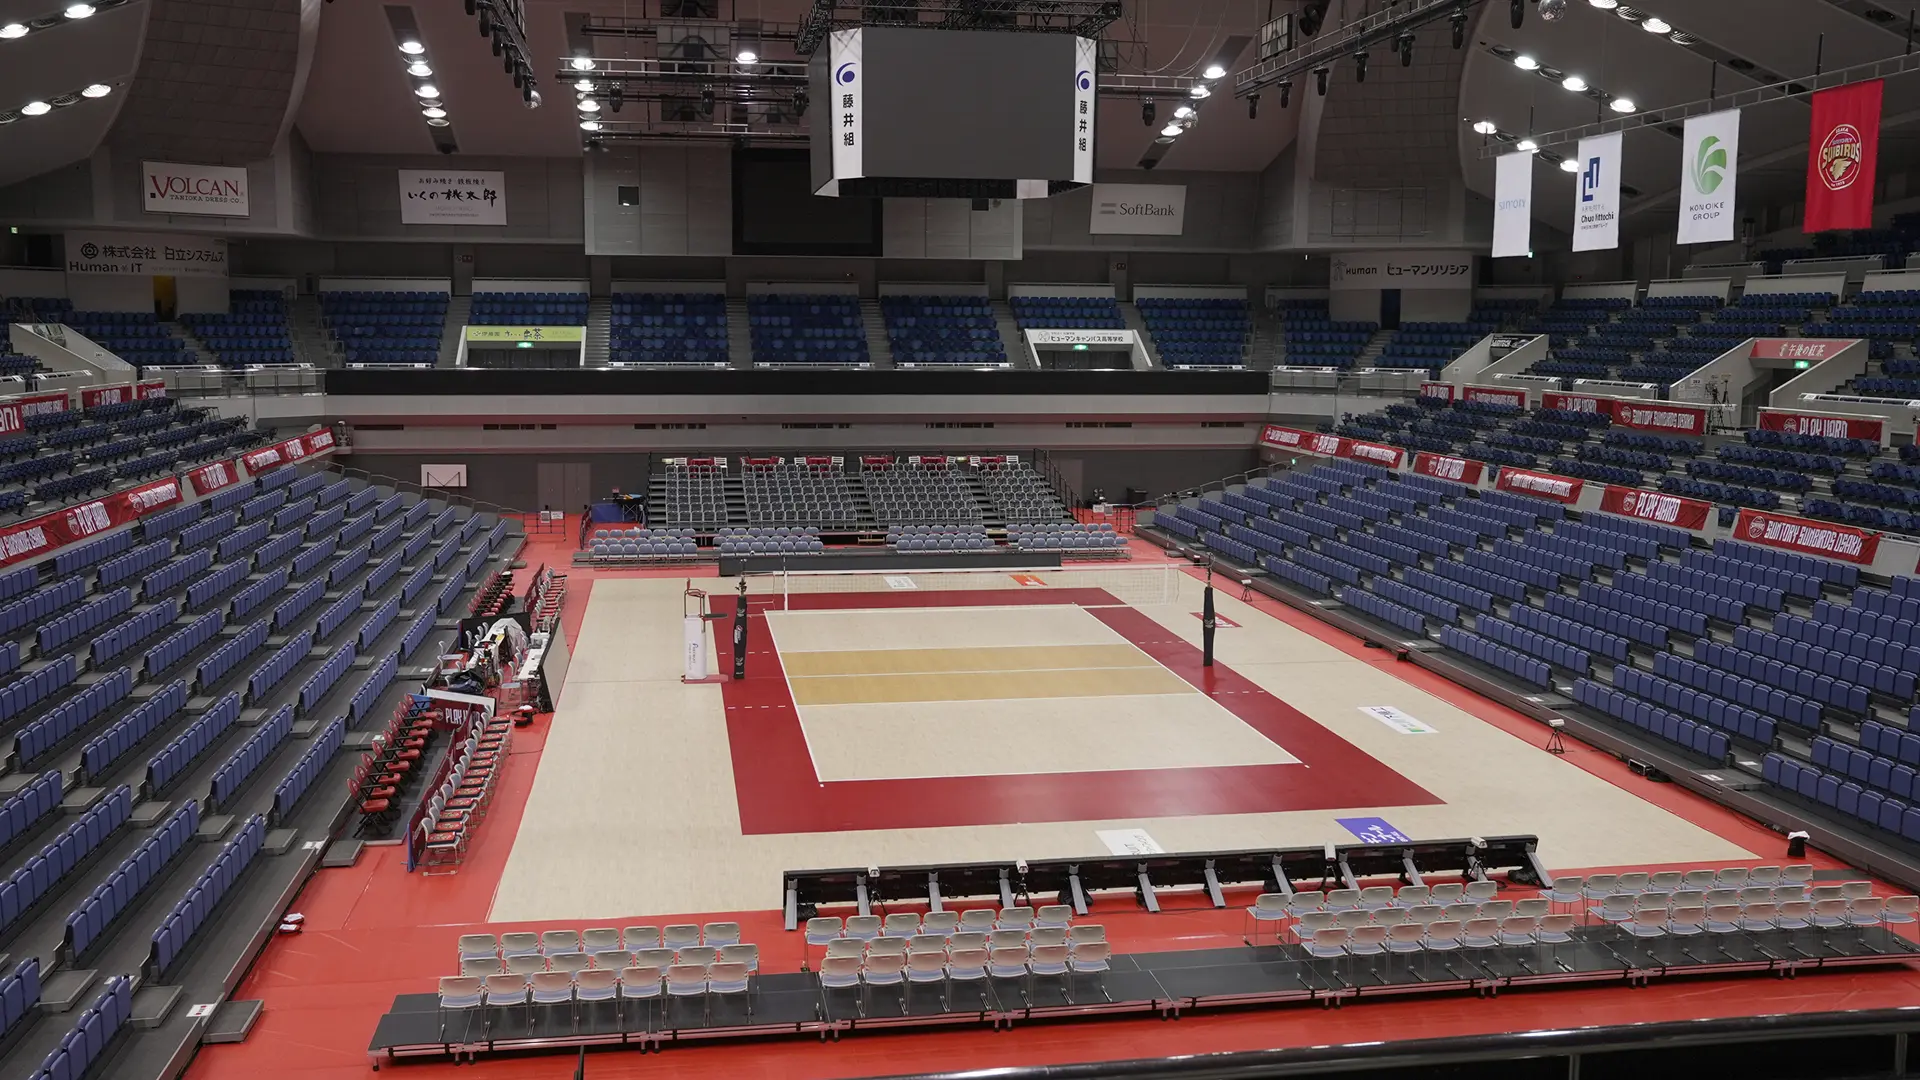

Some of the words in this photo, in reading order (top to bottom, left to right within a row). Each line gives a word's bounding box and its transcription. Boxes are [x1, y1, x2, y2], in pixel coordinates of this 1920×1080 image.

[842, 93, 855, 147] 藤井組
[1078, 100, 1088, 152] 藤井組
[150, 174, 240, 199] VOLCAN
[169, 194, 204, 202] TANIOKA
[206, 195, 228, 203] DRESS
[407, 187, 498, 209] いくの桃太郎
[1690, 201, 1725, 212] KONOIKE
[1119, 202, 1175, 216] SoftBank
[1693, 211, 1720, 221] GROUP
[103, 246, 157, 260] 株式会社
[164, 246, 225, 263] 日立システムズ
[69, 261, 119, 273] Human
[131, 263, 143, 273] IT
[1386, 263, 1469, 276] ヒューマンリソシア
[1634, 492, 1661, 519] PLAY
[1654, 496, 1682, 523] HARD
[1764, 520, 1801, 544] SUNTORY
[1797, 526, 1837, 551] SUNBIRDS
[1834, 532, 1863, 557] OSAKA
[445, 707, 463, 725] PLAY
